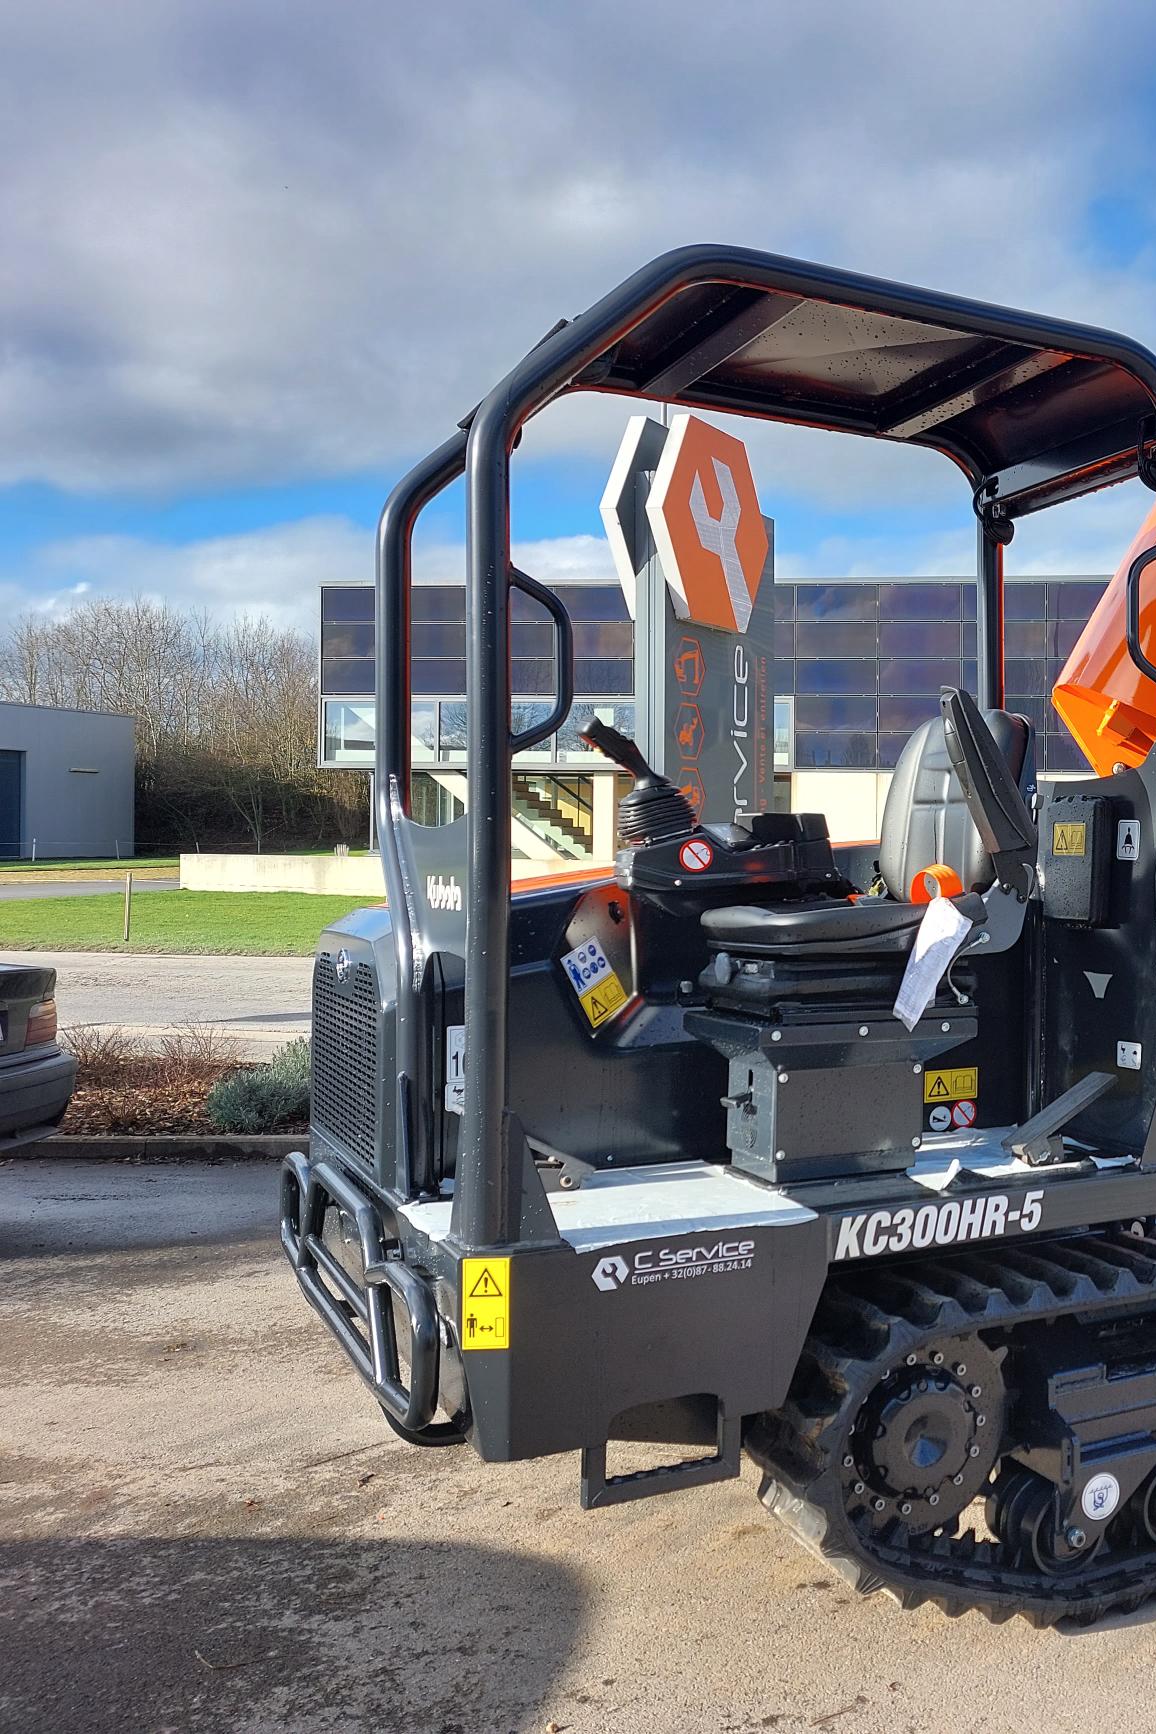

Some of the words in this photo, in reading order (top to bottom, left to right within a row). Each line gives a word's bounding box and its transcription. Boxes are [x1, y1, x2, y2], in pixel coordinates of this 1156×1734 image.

[426, 875, 462, 911] Kubota
[834, 1190, 1044, 1261] KC300HR-5
[634, 1251, 653, 1269] C
[659, 1240, 755, 1266] Service
[631, 1273, 661, 1285] Eupen
